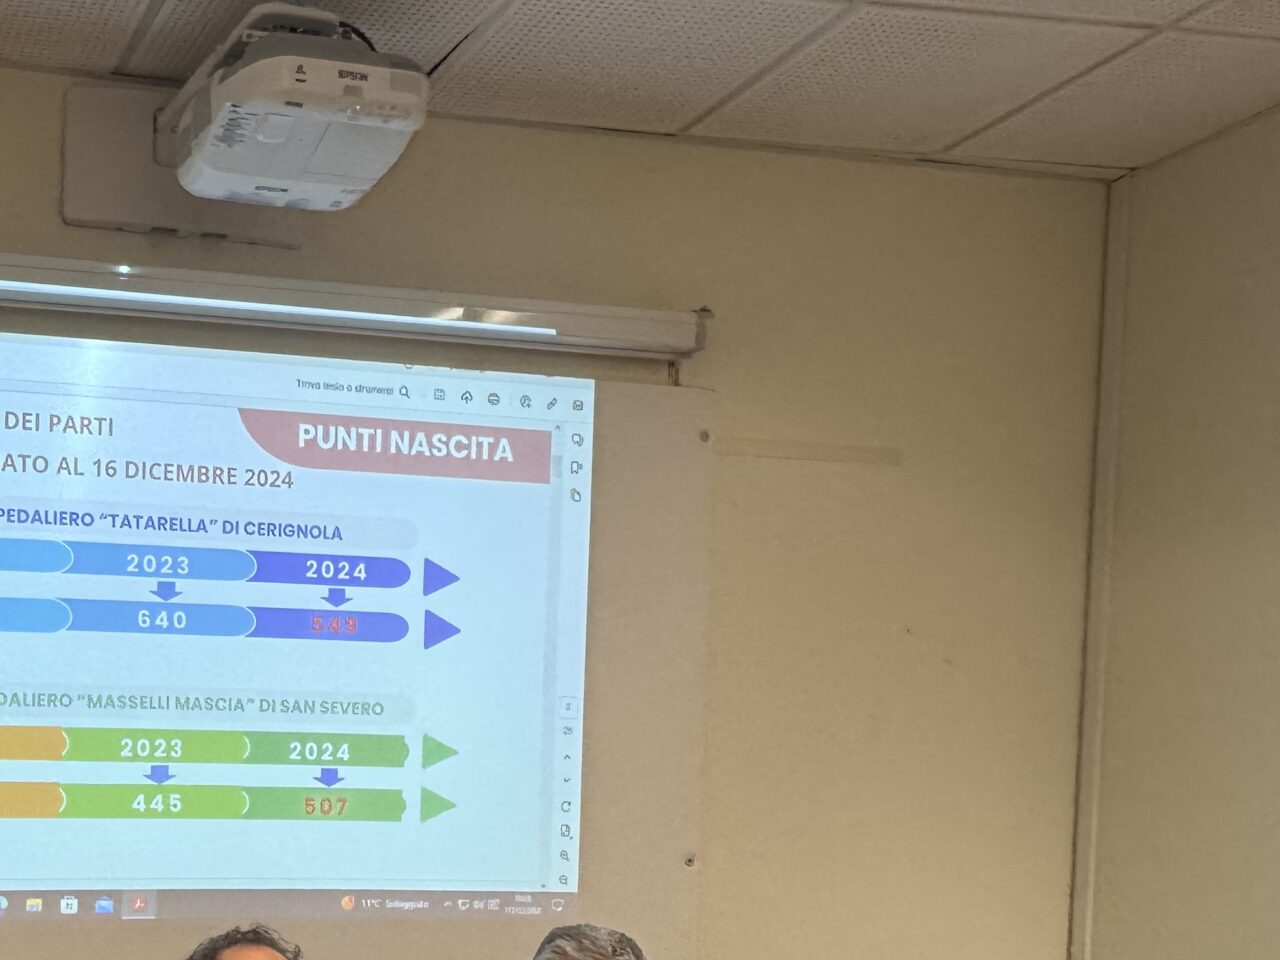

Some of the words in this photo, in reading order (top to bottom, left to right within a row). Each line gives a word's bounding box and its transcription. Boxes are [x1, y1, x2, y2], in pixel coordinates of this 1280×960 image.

[4, 411, 40, 432] DEI
[48, 413, 114, 437] PARTI
[297, 422, 382, 453] PUNTI
[389, 430, 515, 462] NASCITA
[56, 456, 85, 477] AL
[92, 458, 118, 478] 16
[124, 460, 238, 486] DICEMBRE
[243, 468, 294, 489] 2024
[222, 519, 240, 536] DI
[243, 520, 344, 541] CERIGNOLA
[126, 553, 190, 575] 2023
[305, 559, 367, 581] 2024
[137, 609, 188, 630] 640
[311, 615, 359, 635] 549
[258, 699, 276, 714] DI
[279, 700, 316, 715] SAN
[319, 700, 385, 717] SEVERO
[120, 738, 183, 759] 2023
[289, 742, 351, 762] 2024
[131, 794, 183, 813] 445
[304, 796, 350, 816] 507
